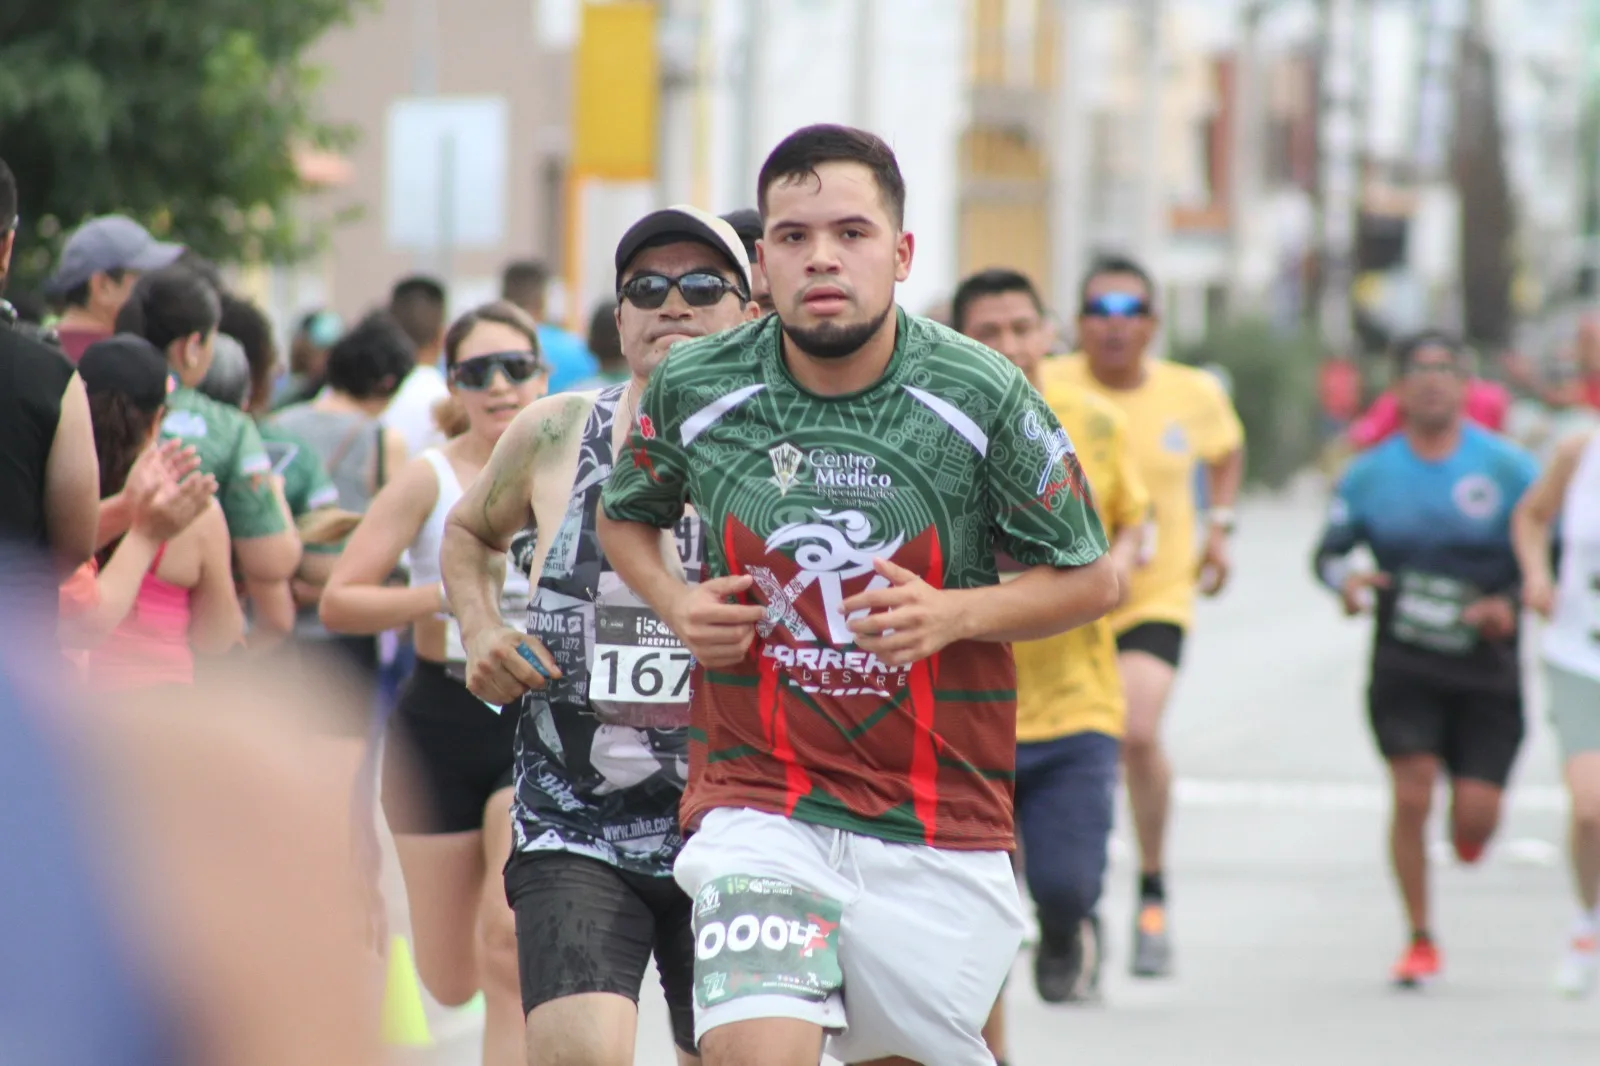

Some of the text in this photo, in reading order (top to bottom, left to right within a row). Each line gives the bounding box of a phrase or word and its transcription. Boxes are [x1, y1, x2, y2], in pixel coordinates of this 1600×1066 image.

[809, 449, 876, 469] Centro
[815, 467, 892, 487] Médico
[538, 612, 552, 632] DO
